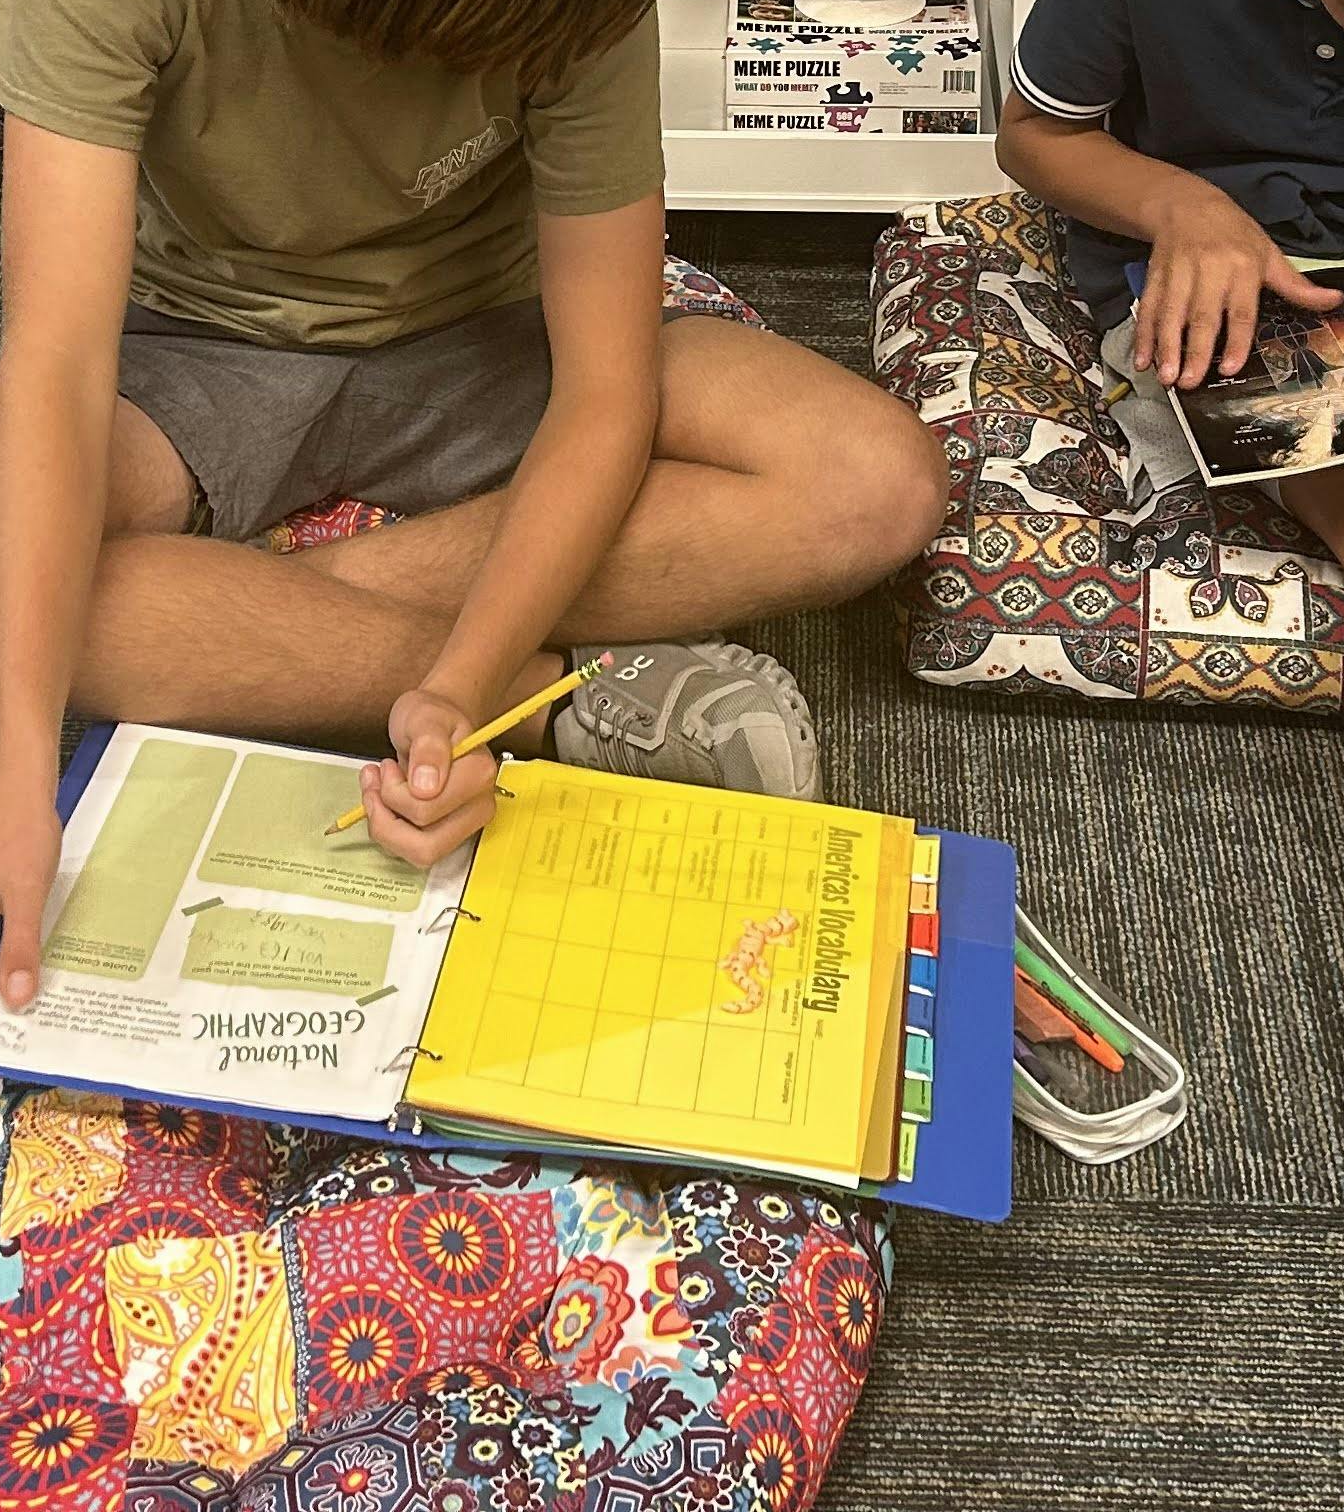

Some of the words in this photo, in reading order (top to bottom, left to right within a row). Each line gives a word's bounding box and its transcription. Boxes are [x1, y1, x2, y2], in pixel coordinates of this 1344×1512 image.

[736, 22, 793, 33] MEME
[798, 25, 864, 35] PUZZLE
[734, 60, 782, 77] MEME
[785, 60, 841, 77] PUZZLE
[735, 83, 758, 92] WHAT
[760, 83, 771, 92] DO
[773, 83, 789, 92] YOU
[790, 83, 819, 93] MEME?
[733, 114, 774, 129] MEME
[777, 115, 825, 130] PUZZLE
[821, 825, 863, 906] Americas
[801, 908, 856, 1014] Vocabulary
[191, 1009, 366, 1040] GEOGRAPHIC
[218, 1042, 339, 1071] National
